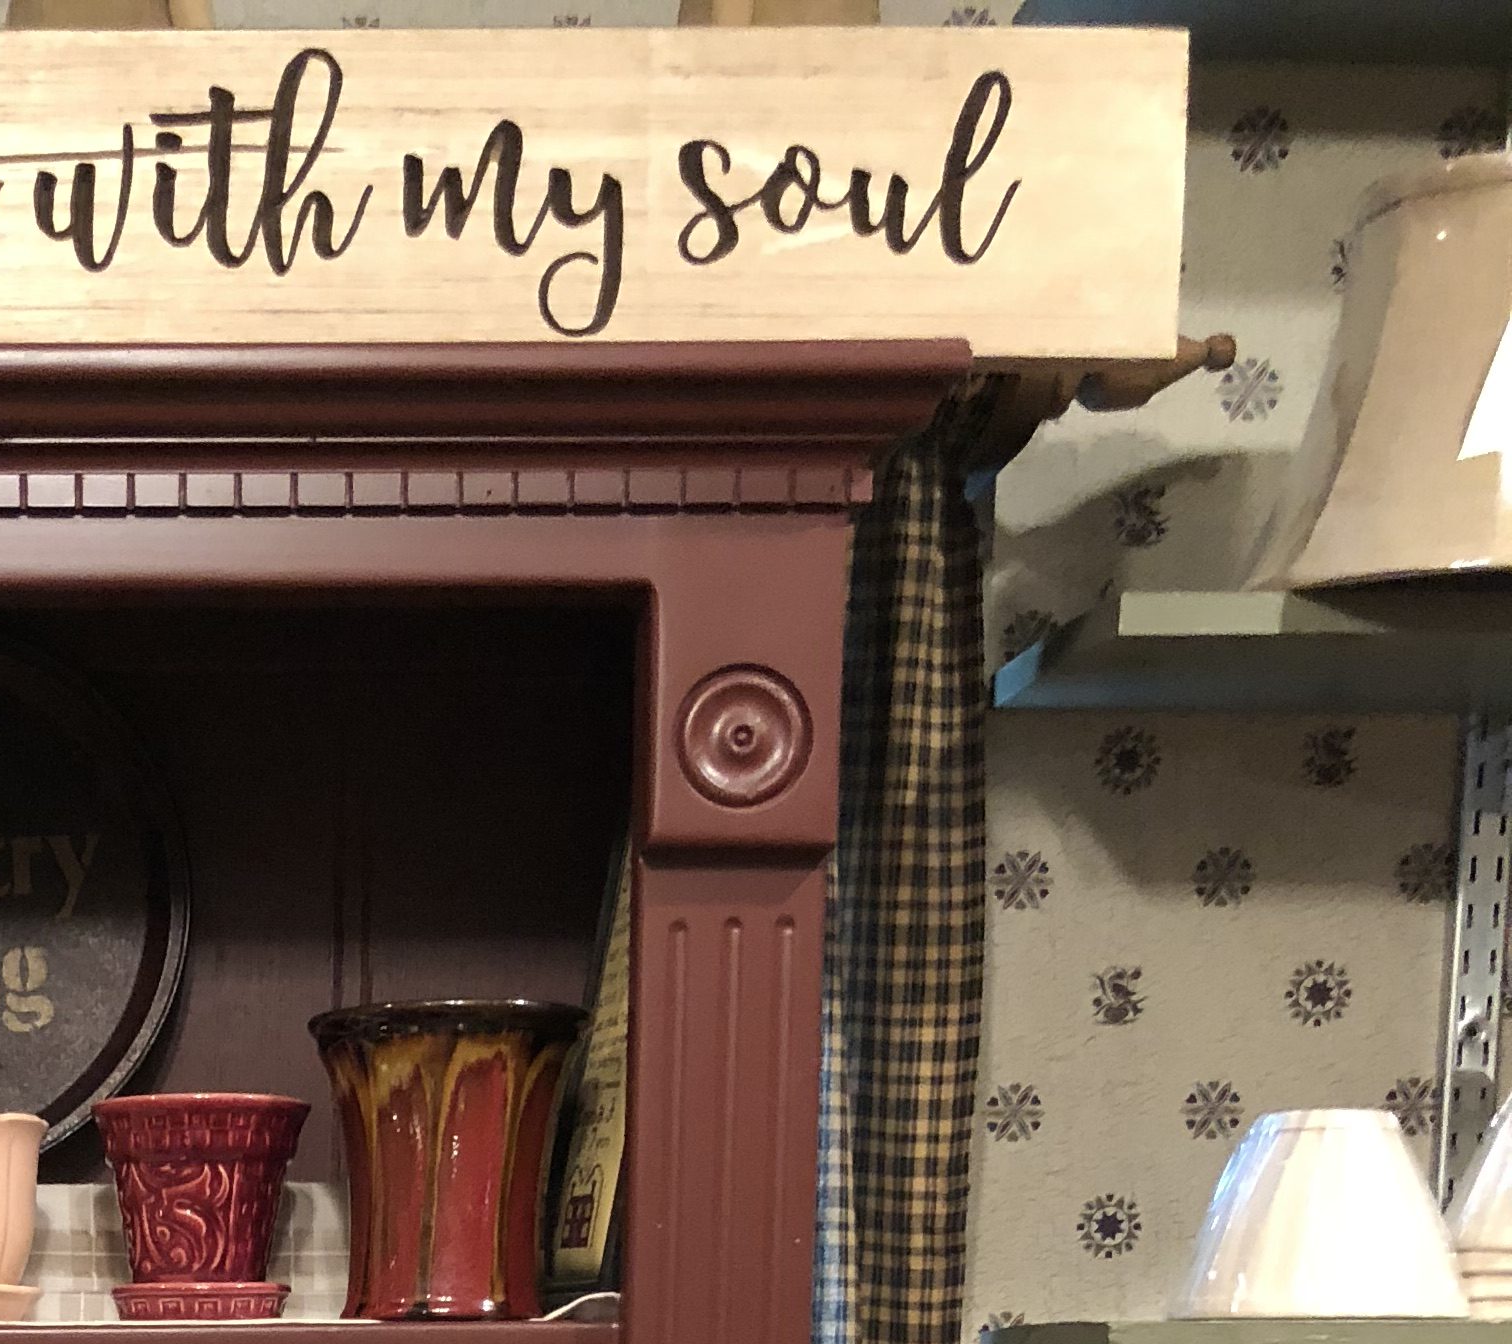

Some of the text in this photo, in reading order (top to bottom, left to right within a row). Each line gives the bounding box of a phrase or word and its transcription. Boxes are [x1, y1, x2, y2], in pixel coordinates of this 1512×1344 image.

[34, 47, 373, 277] with
[402, 119, 624, 338] my
[678, 69, 1023, 265] soul
